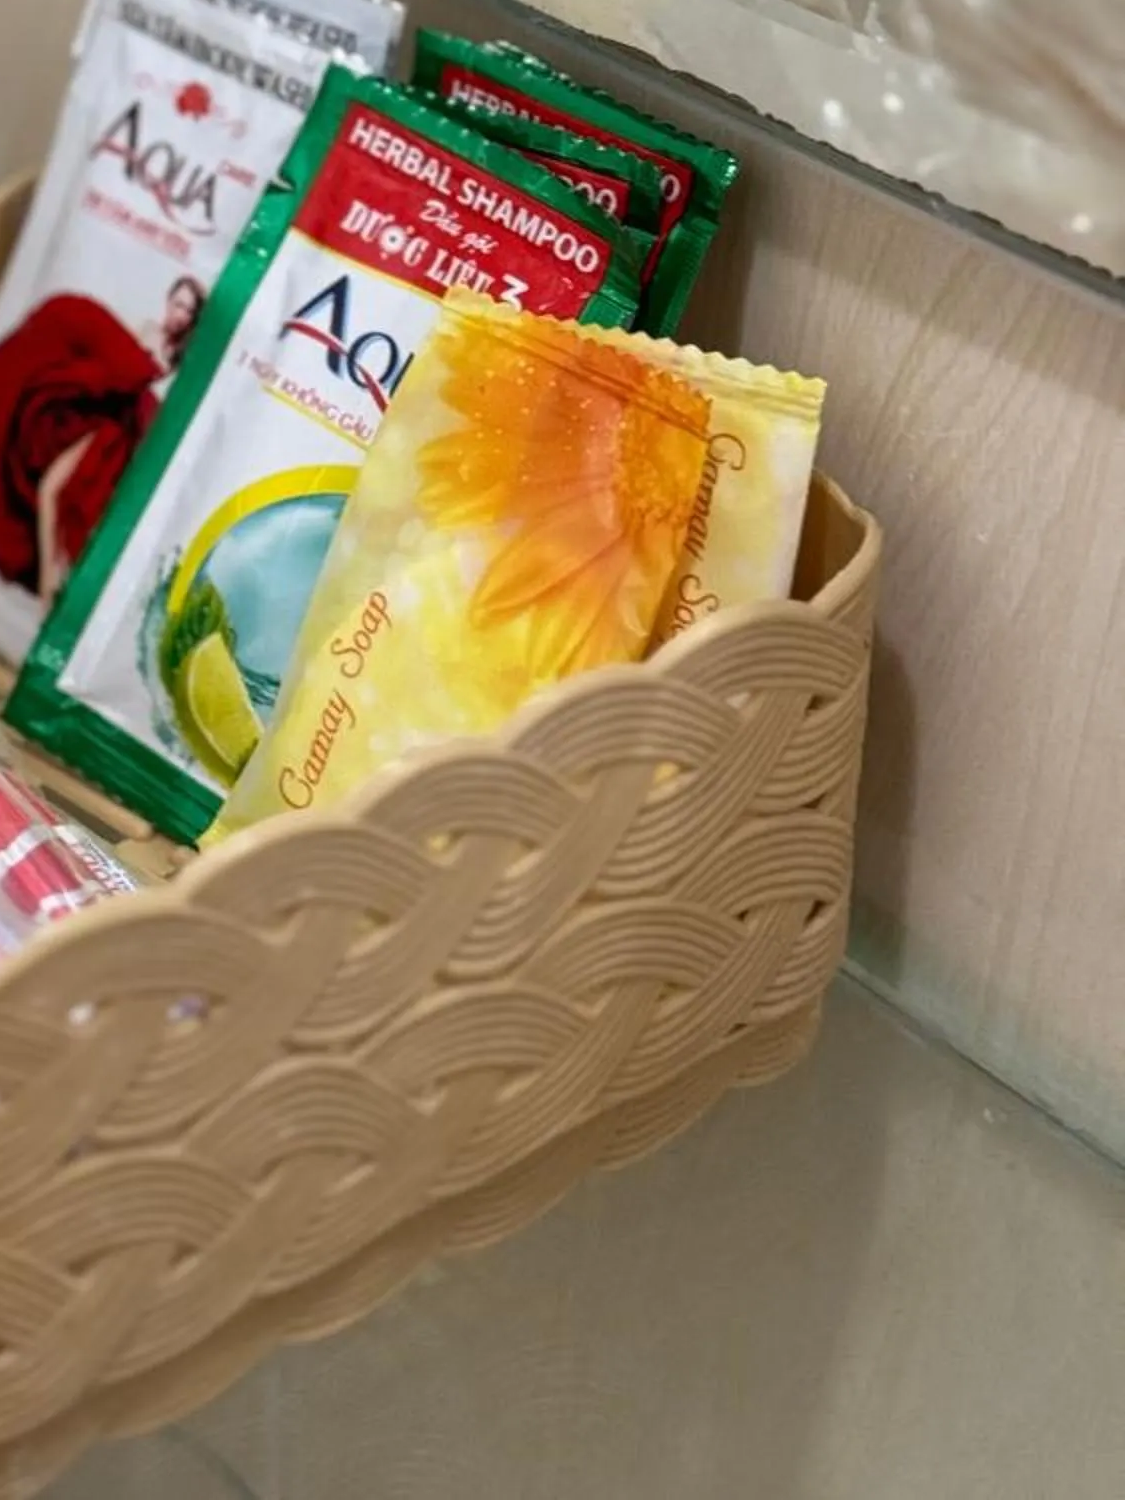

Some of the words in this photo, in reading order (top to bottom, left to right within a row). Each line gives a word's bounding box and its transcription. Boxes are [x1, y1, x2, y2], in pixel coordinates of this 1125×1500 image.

[89, 98, 217, 235] AQUA
[348, 116, 454, 196] HERBAL
[456, 178, 600, 273] SHAMPOO
[278, 274, 415, 415] AQ
[671, 573, 720, 638] So
[278, 687, 356, 810] Camay
[330, 590, 393, 679] Soap
